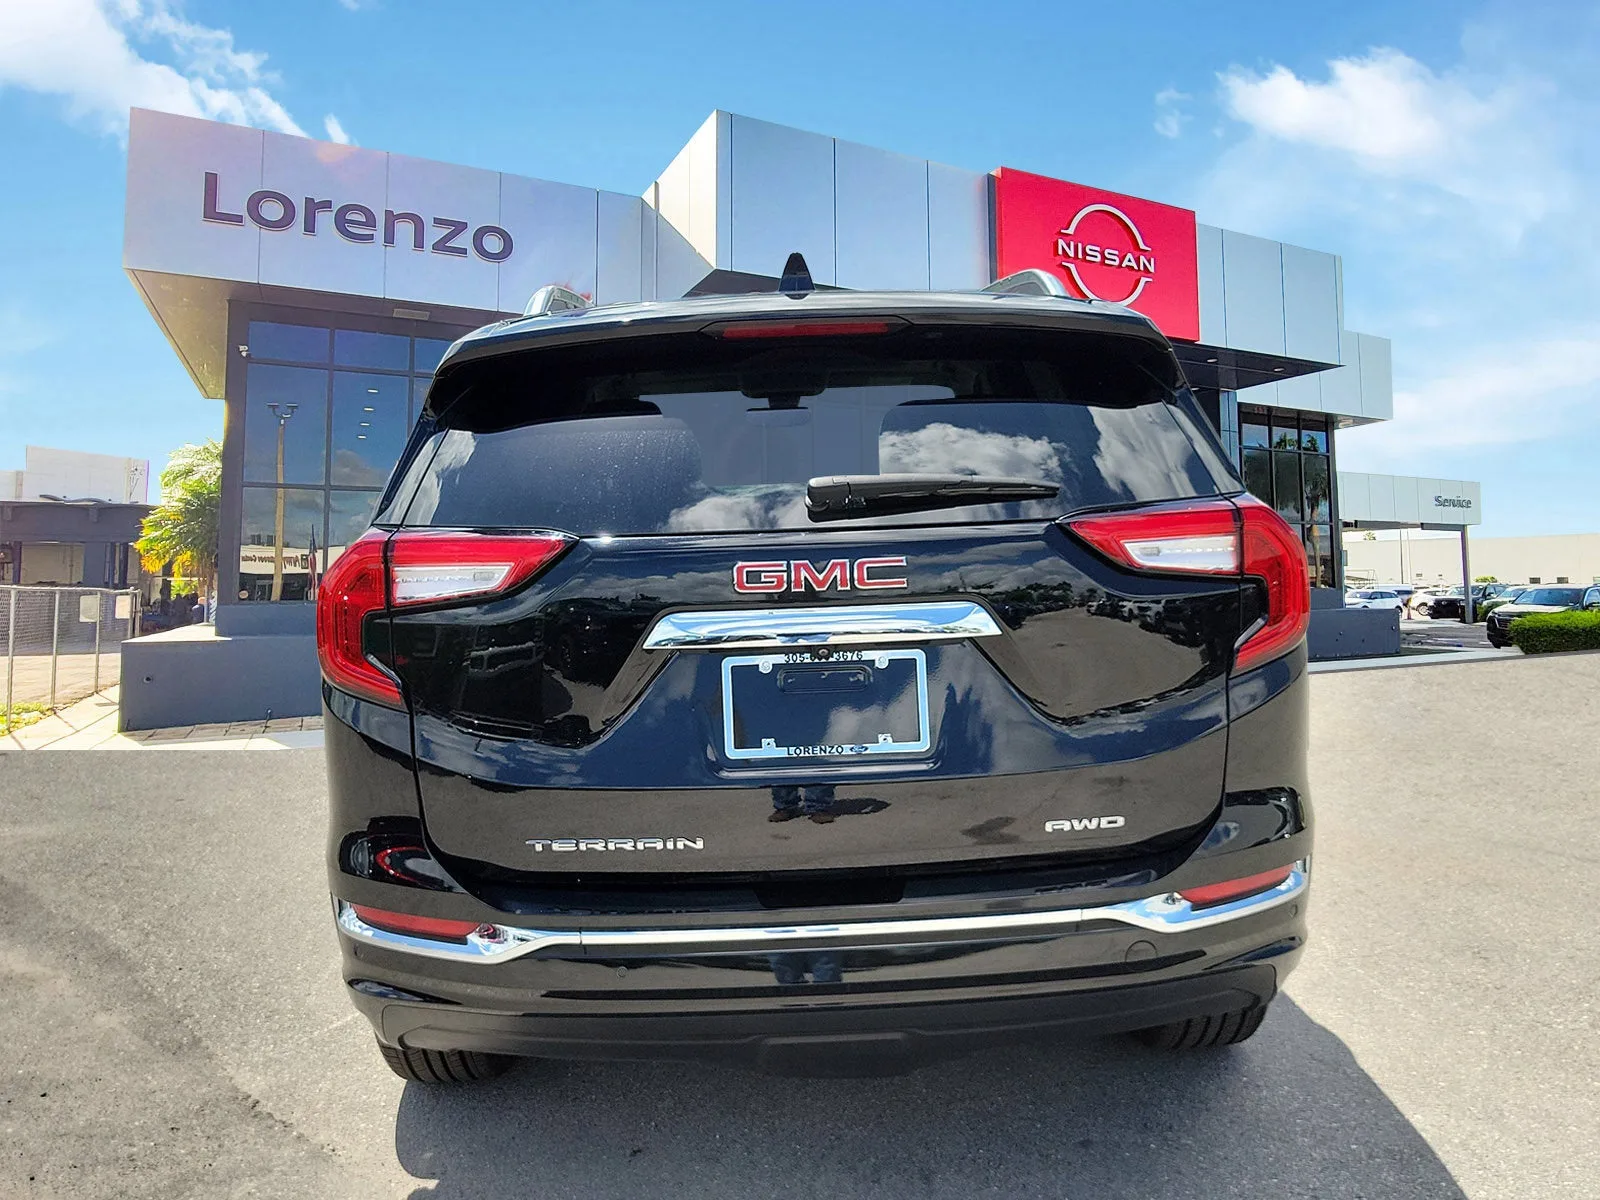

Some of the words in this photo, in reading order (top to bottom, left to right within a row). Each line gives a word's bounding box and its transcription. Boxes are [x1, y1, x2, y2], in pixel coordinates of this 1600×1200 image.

[202, 171, 515, 262] Lorenzo
[1057, 238, 1155, 273] NISSAN
[1434, 495, 1472, 508] Service
[733, 556, 908, 593] GMC
[787, 745, 844, 756] LORENZO
[1045, 815, 1126, 833] AWD
[525, 837, 704, 852] TERRAIN
